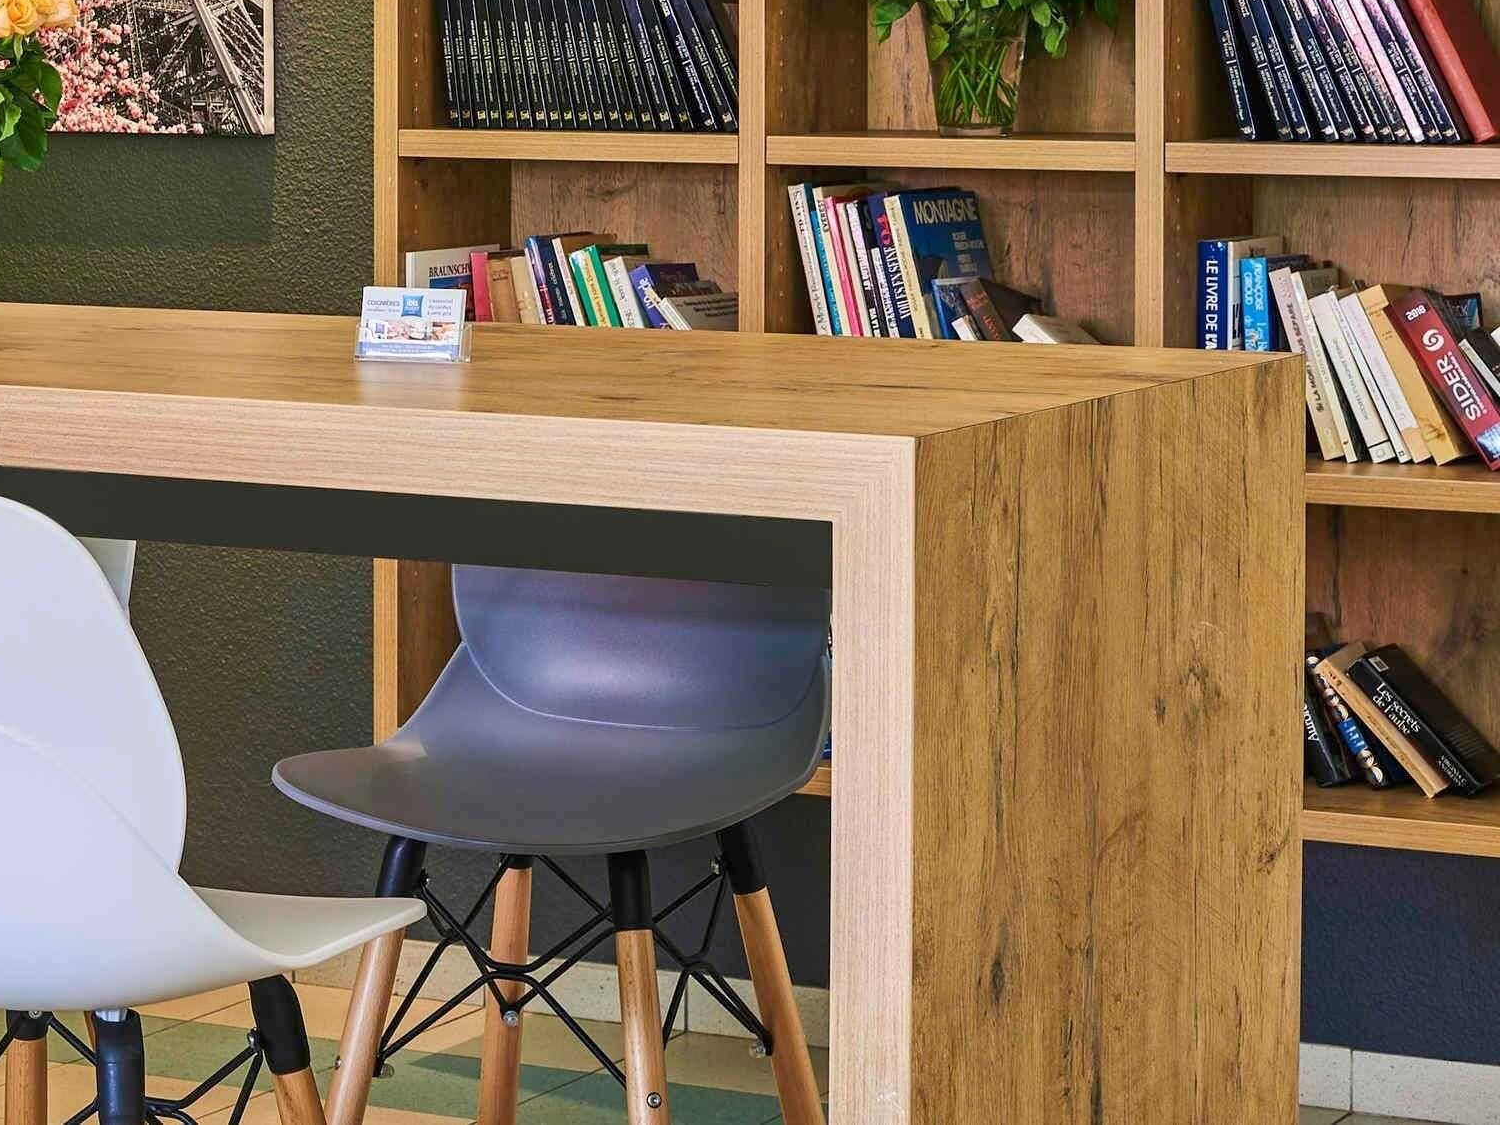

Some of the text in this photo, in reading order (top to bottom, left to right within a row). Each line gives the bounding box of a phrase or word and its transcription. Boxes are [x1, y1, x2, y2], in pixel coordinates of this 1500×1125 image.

[913, 199, 979, 225] MONTAGNE
[1206, 260, 1218, 273] LE
[1206, 276, 1218, 310] LIVRE
[1206, 313, 1218, 331] DE
[1406, 305, 1427, 321] 2018
[1311, 388, 1321, 401] LA
[1436, 355, 1482, 421] SIDER
[1372, 695, 1411, 735] de l'aube
[1376, 682, 1421, 733] Les secrets
